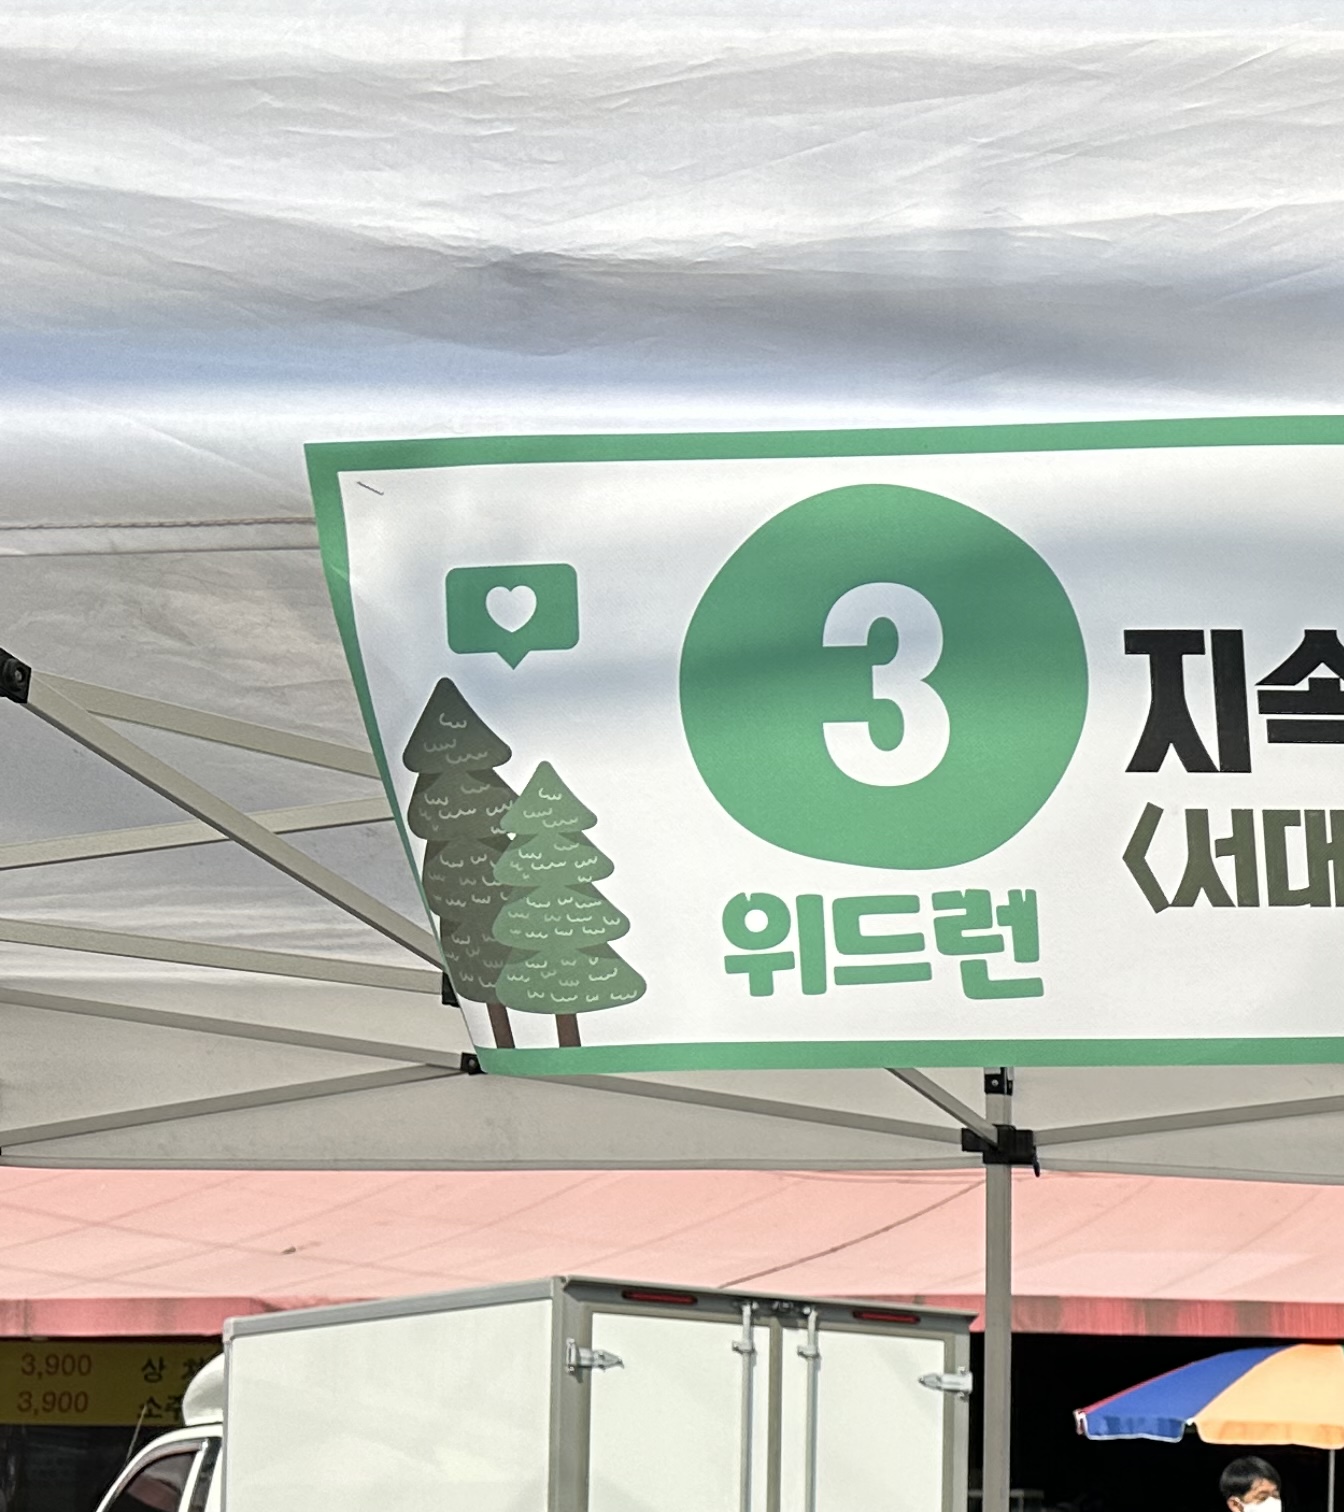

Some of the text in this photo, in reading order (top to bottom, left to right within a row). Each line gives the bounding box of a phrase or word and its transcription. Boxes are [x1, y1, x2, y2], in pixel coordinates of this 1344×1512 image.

[823, 583, 951, 787] 3
[721, 888, 1044, 1001] 위드런
[20, 1353, 93, 1380] 3,900
[16, 1390, 90, 1416] 3,900
